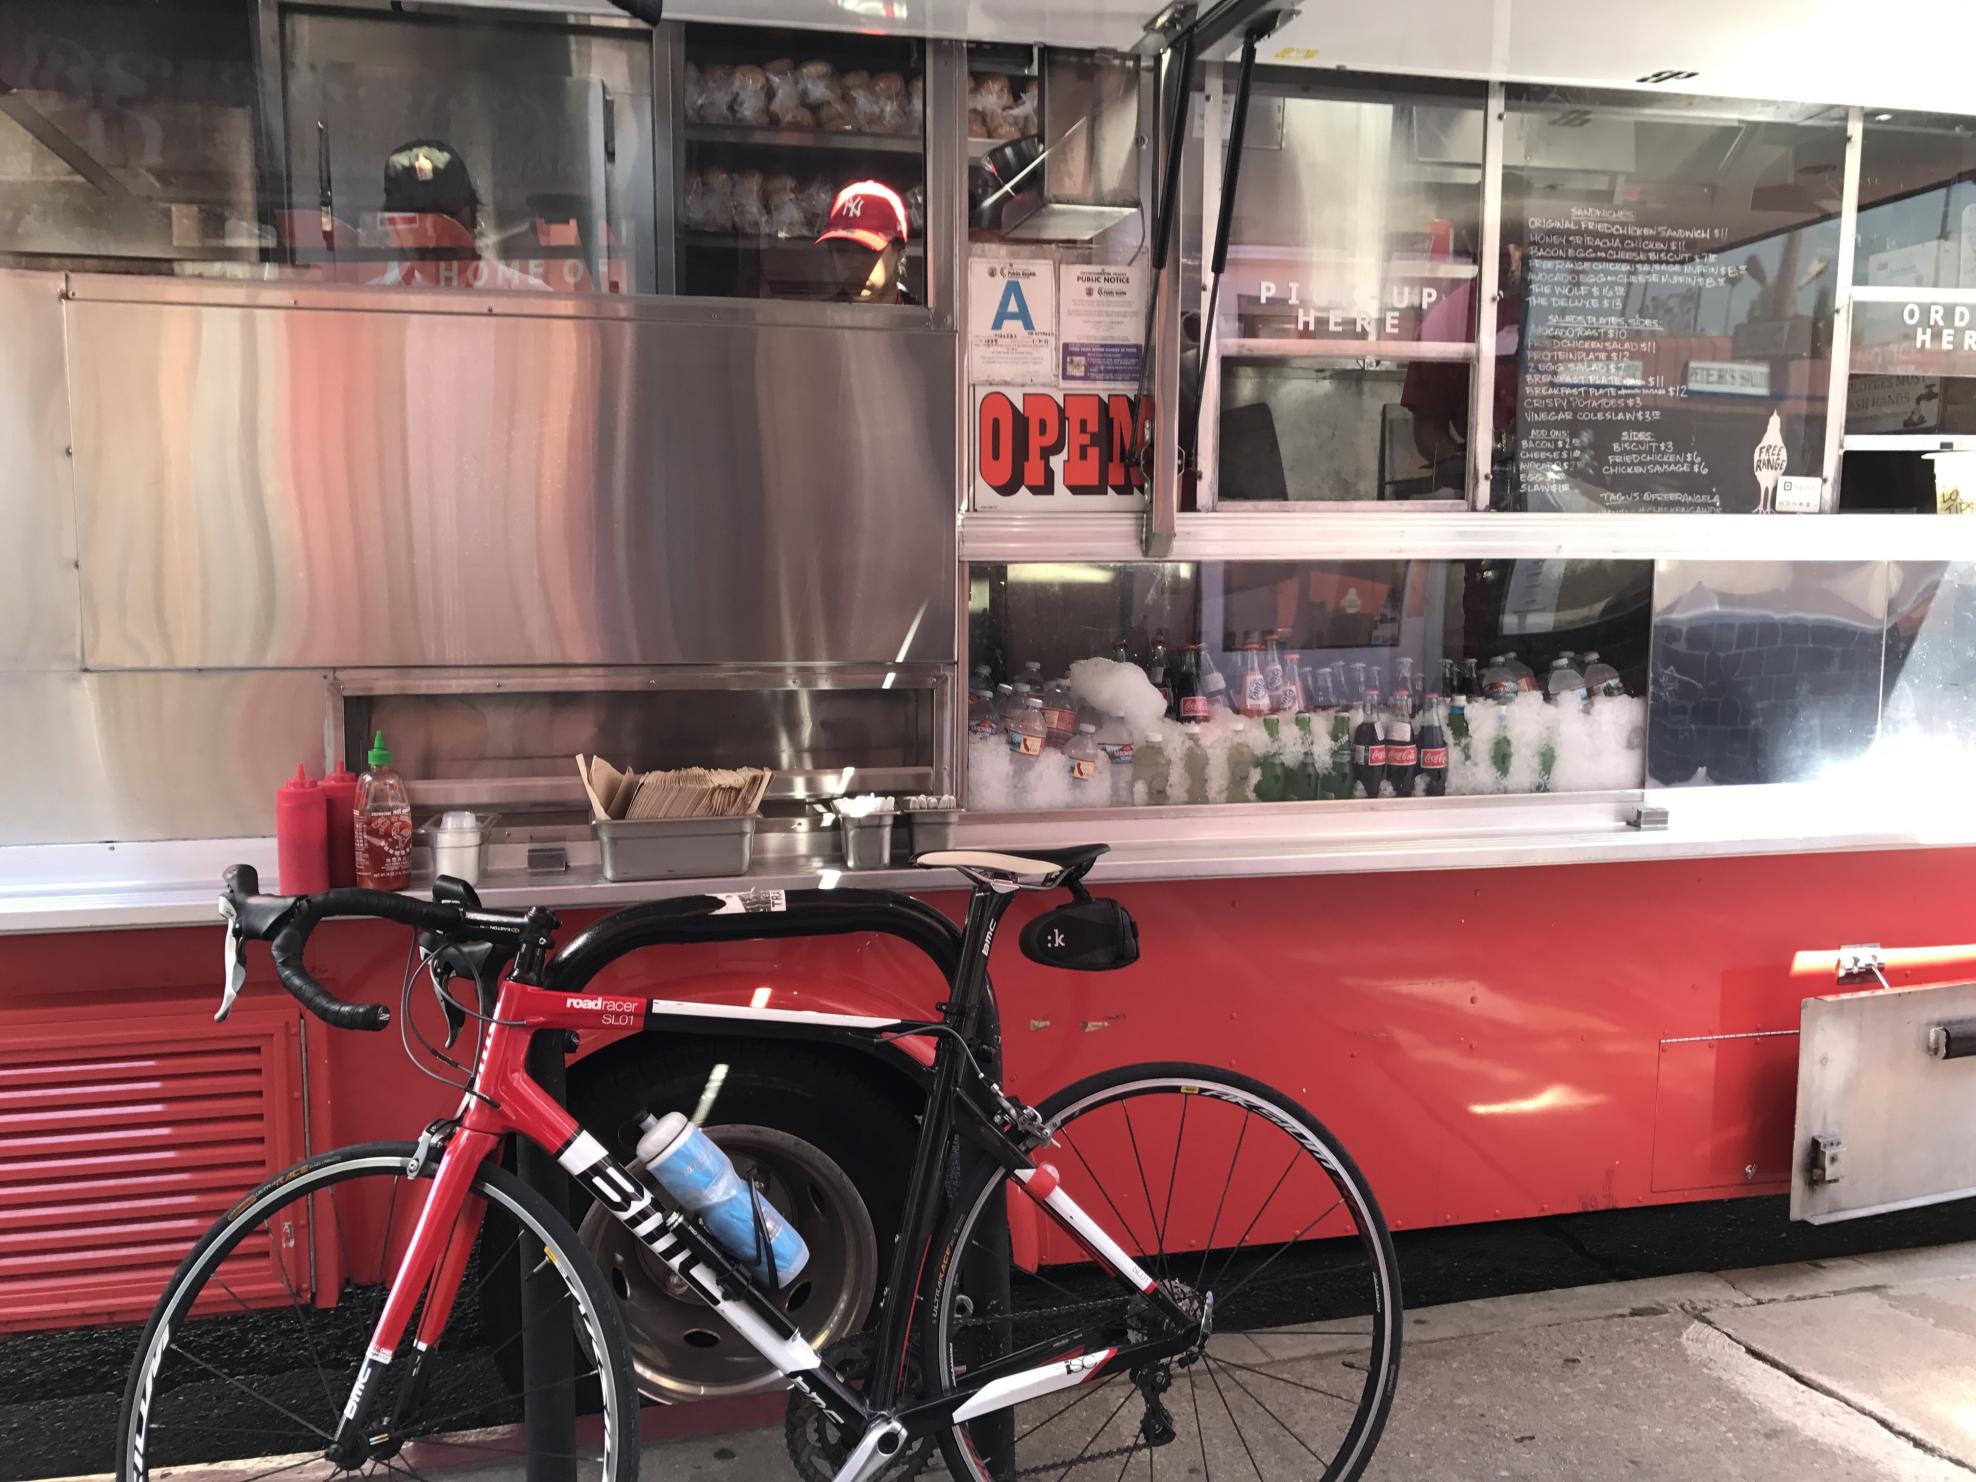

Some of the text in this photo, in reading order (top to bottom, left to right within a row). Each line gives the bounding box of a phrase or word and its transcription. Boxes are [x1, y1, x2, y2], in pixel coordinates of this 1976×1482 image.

[842, 196, 864, 218] NY
[1529, 220, 1579, 230] ORIGINAL
[1659, 226, 1710, 239] SANDWICH
[1714, 227, 1729, 239] $11
[1529, 233, 1686, 251] HONEY SRIRACHA CHICKEN $11
[1530, 247, 1565, 258] BACON
[1648, 252, 1692, 262] BISCUIT
[440, 259, 545, 289] HOME
[1077, 275, 1130, 285] PUBLIC NOTICE
[1529, 284, 1551, 295] THE
[1554, 285, 1588, 296] WOLF
[1392, 286, 1438, 310] UP
[1527, 297, 1549, 307] THE
[1552, 298, 1601, 309] DELUXE
[991, 279, 1036, 331] A
[1298, 307, 1400, 334] HERE
[1903, 303, 1970, 328] ORD
[1607, 328, 1628, 339] $10
[1604, 342, 1639, 351] SALAD
[1640, 342, 1657, 353] $11
[1611, 352, 1631, 361] $12
[1589, 375, 1623, 385] PLATE
[1648, 376, 1664, 387] $11
[1525, 387, 1588, 396] BREAKFAST
[1589, 388, 1617, 397] PLATE
[1667, 386, 1688, 398] $12
[1524, 397, 1642, 410] CRISPY POTATOES $3
[1872, 392, 1910, 408] HANDS
[1525, 410, 1573, 422] VINEGAR
[1577, 411, 1636, 421] COLESLAW
[1521, 439, 1554, 449] BACON
[1613, 441, 1674, 453] BISCUIT $3
[1520, 449, 1560, 460] CHEESE
[1608, 451, 1701, 464] FRIED CHICKEN $6
[1758, 444, 1784, 458] FREE
[1602, 462, 1709, 475] CHICKEN SAUSAGE $6
[1755, 457, 1786, 473] RANGE
[1520, 483, 1550, 493] SLAW
[1247, 678, 1265, 701] Fanta
[566, 997, 638, 1013] roadracer
[602, 1014, 634, 1026] SL01
